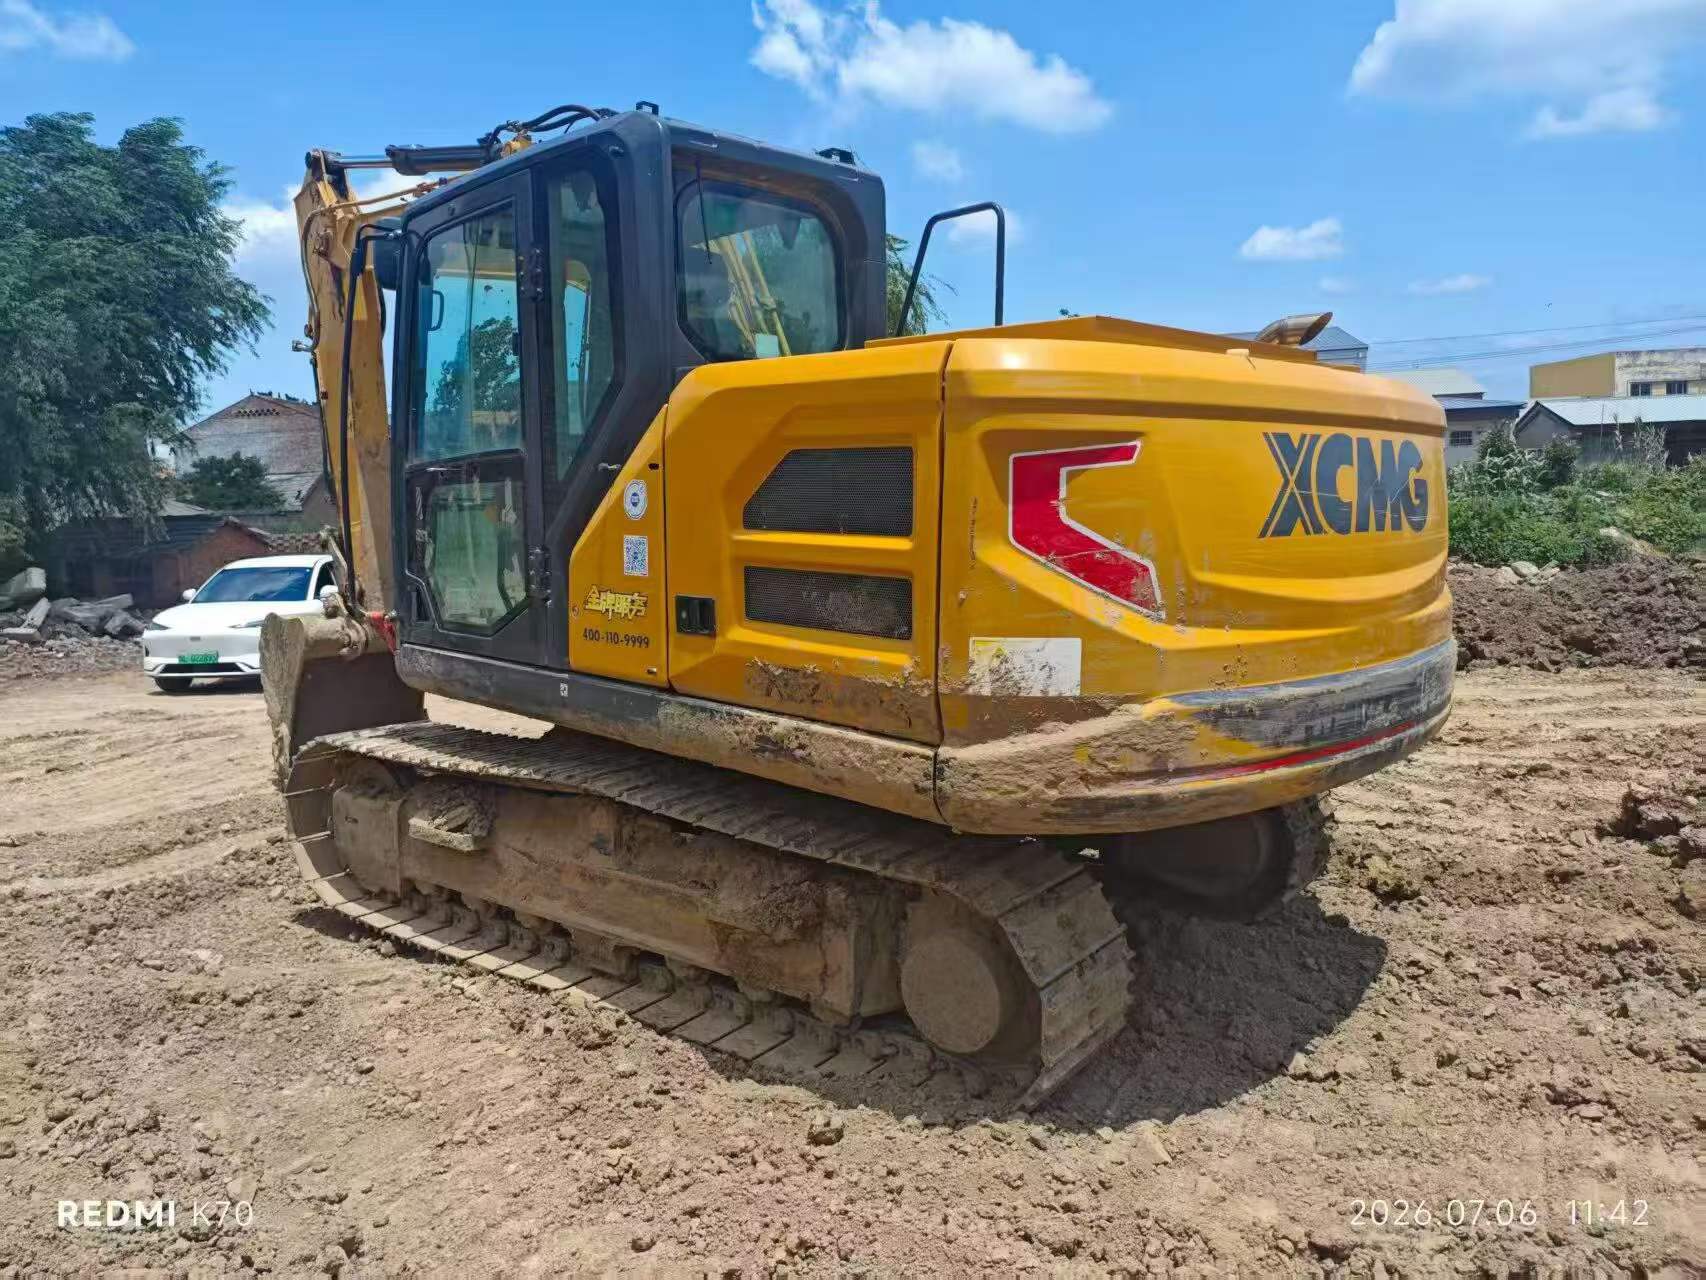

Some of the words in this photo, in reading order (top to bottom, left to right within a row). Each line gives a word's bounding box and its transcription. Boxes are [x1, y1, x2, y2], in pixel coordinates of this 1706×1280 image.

[1257, 432, 1428, 538] XCMG
[585, 585, 648, 620] 金牌服务
[584, 628, 649, 648] 400-110-9999
